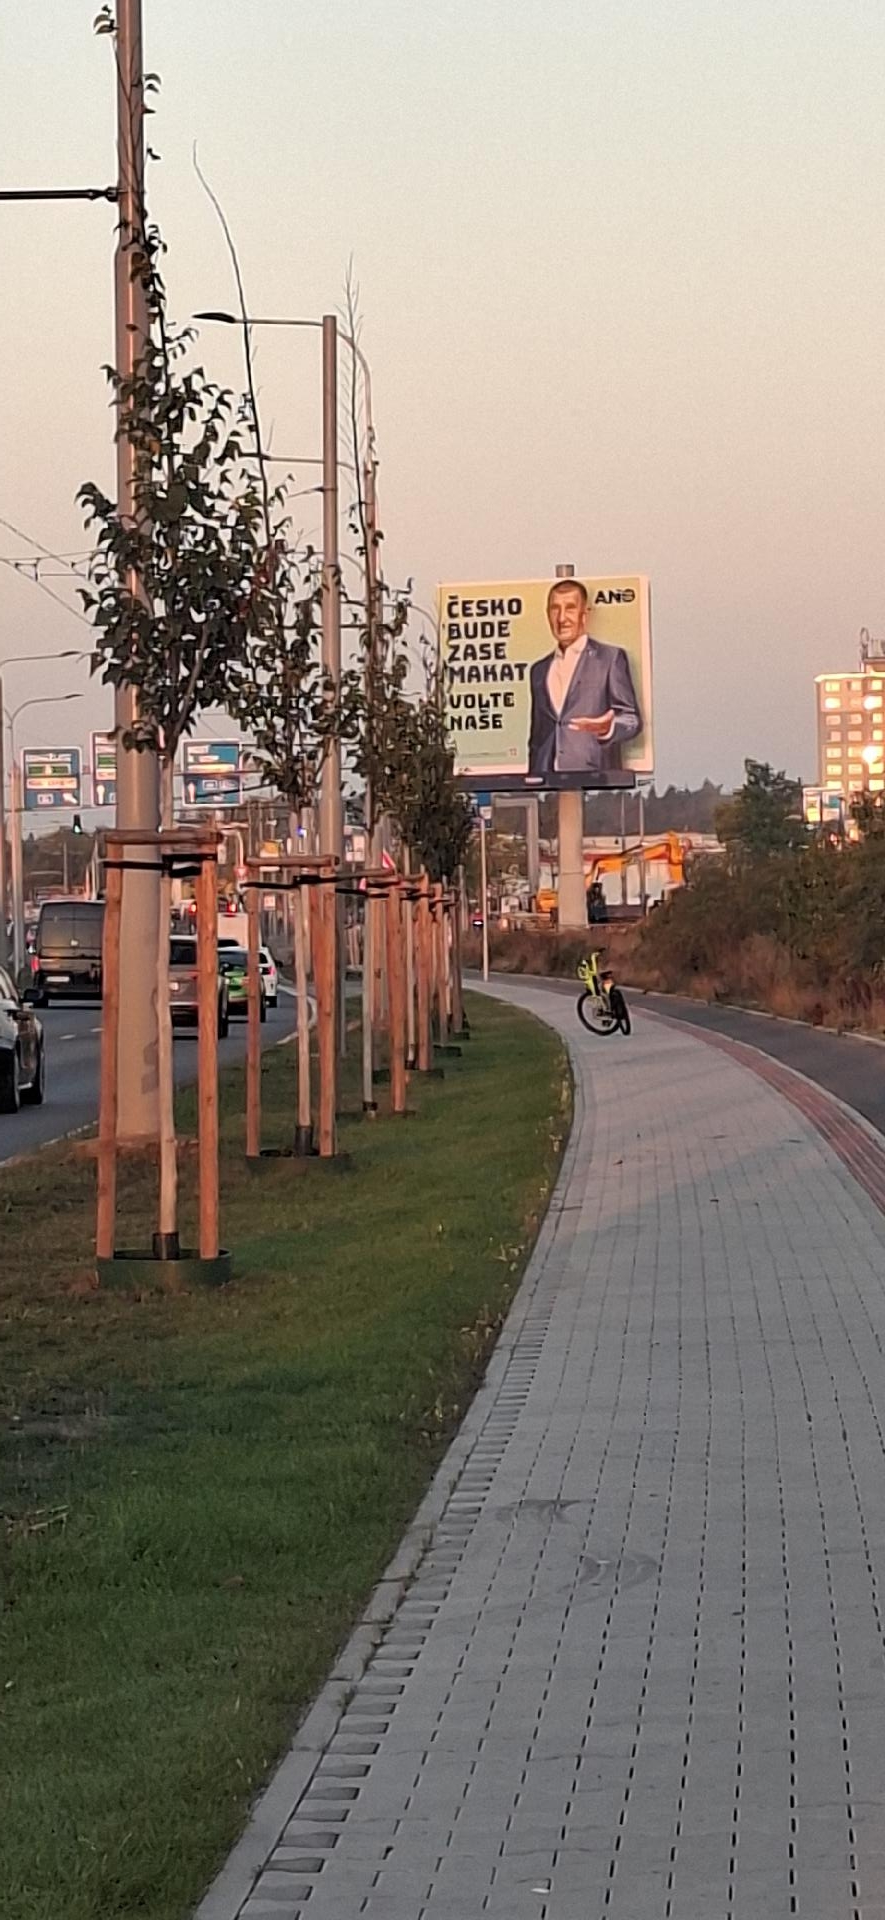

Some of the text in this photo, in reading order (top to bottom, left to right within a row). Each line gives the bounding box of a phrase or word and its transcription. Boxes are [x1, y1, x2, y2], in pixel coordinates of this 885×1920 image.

[447, 595, 522, 618] ČESKO
[448, 620, 511, 640] BUDE
[448, 643, 507, 663] ZASE
[449, 663, 528, 684] MAKAT
[450, 692, 515, 709] VOLTE
[450, 709, 503, 731] NAŠE
